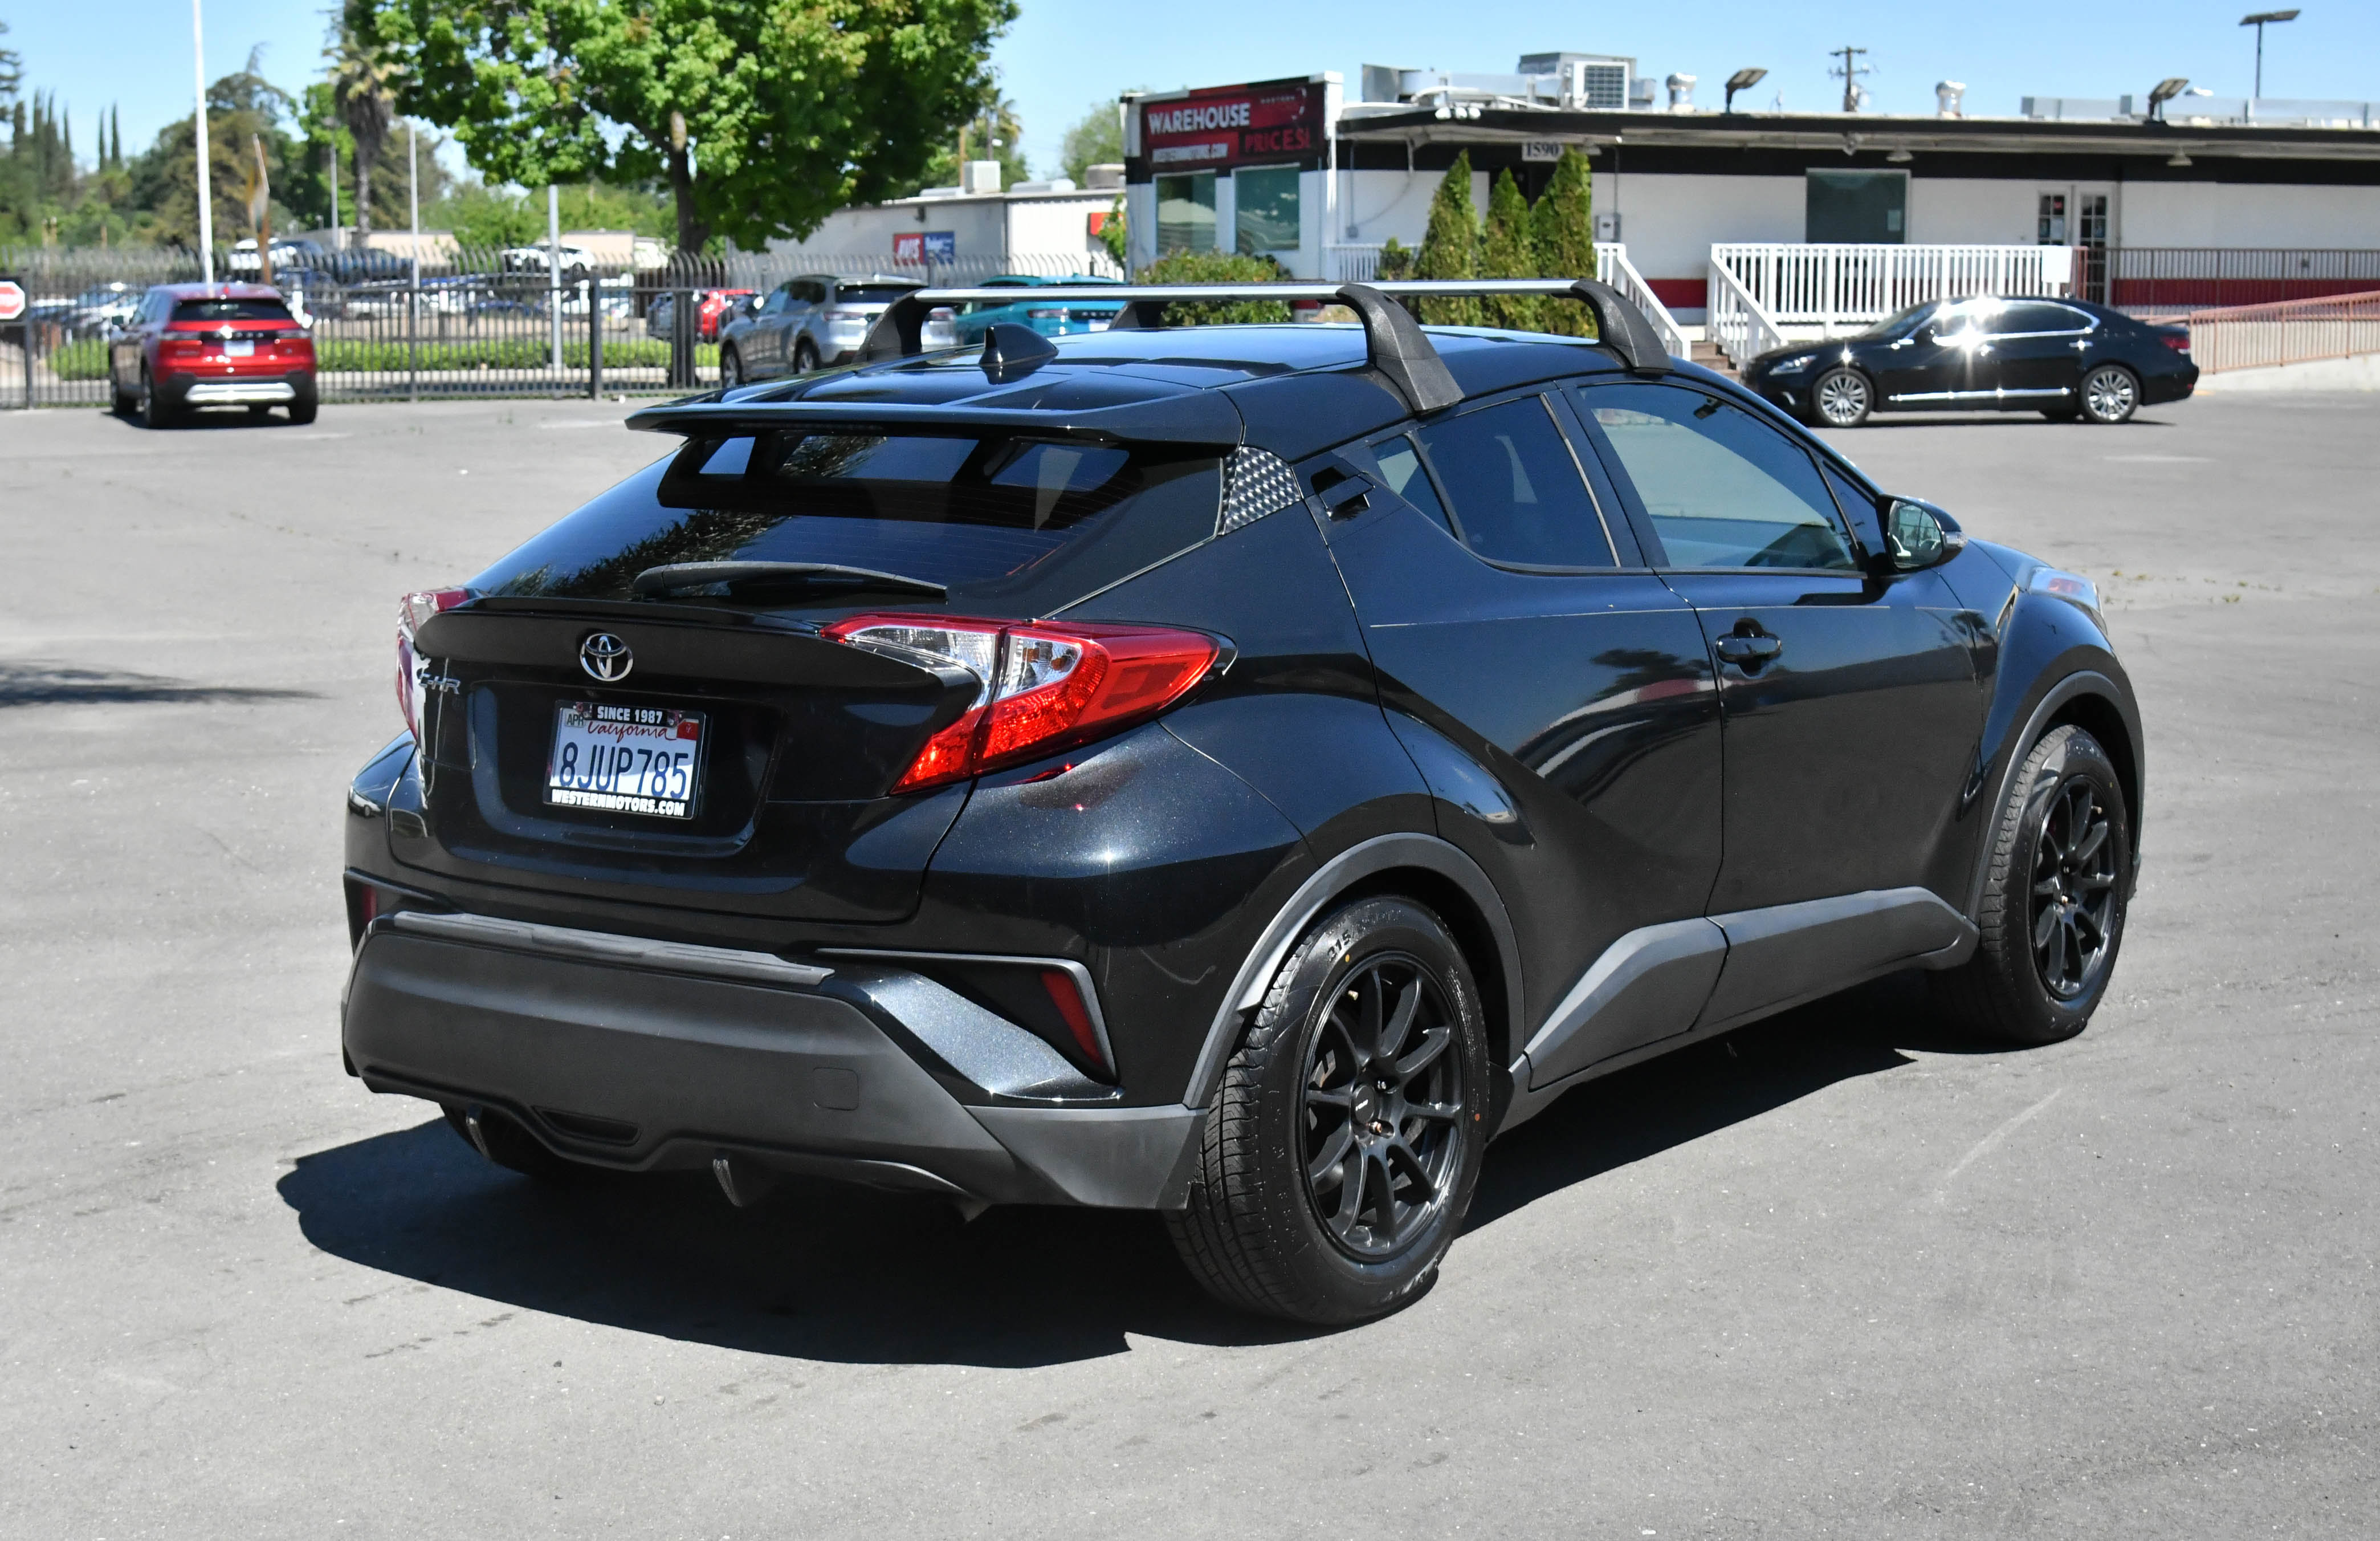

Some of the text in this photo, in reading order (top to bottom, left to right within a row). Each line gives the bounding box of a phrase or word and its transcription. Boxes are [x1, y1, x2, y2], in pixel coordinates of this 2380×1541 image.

[1148, 103, 1250, 135] WAREHOUSE
[1526, 143, 1559, 157] 1590
[567, 713, 584, 726] APR
[597, 705, 663, 725] SINCE 1987
[588, 721, 677, 743] California
[559, 741, 689, 799] 8JUP785
[551, 788, 686, 816] WESTERNMOTORS.COM
